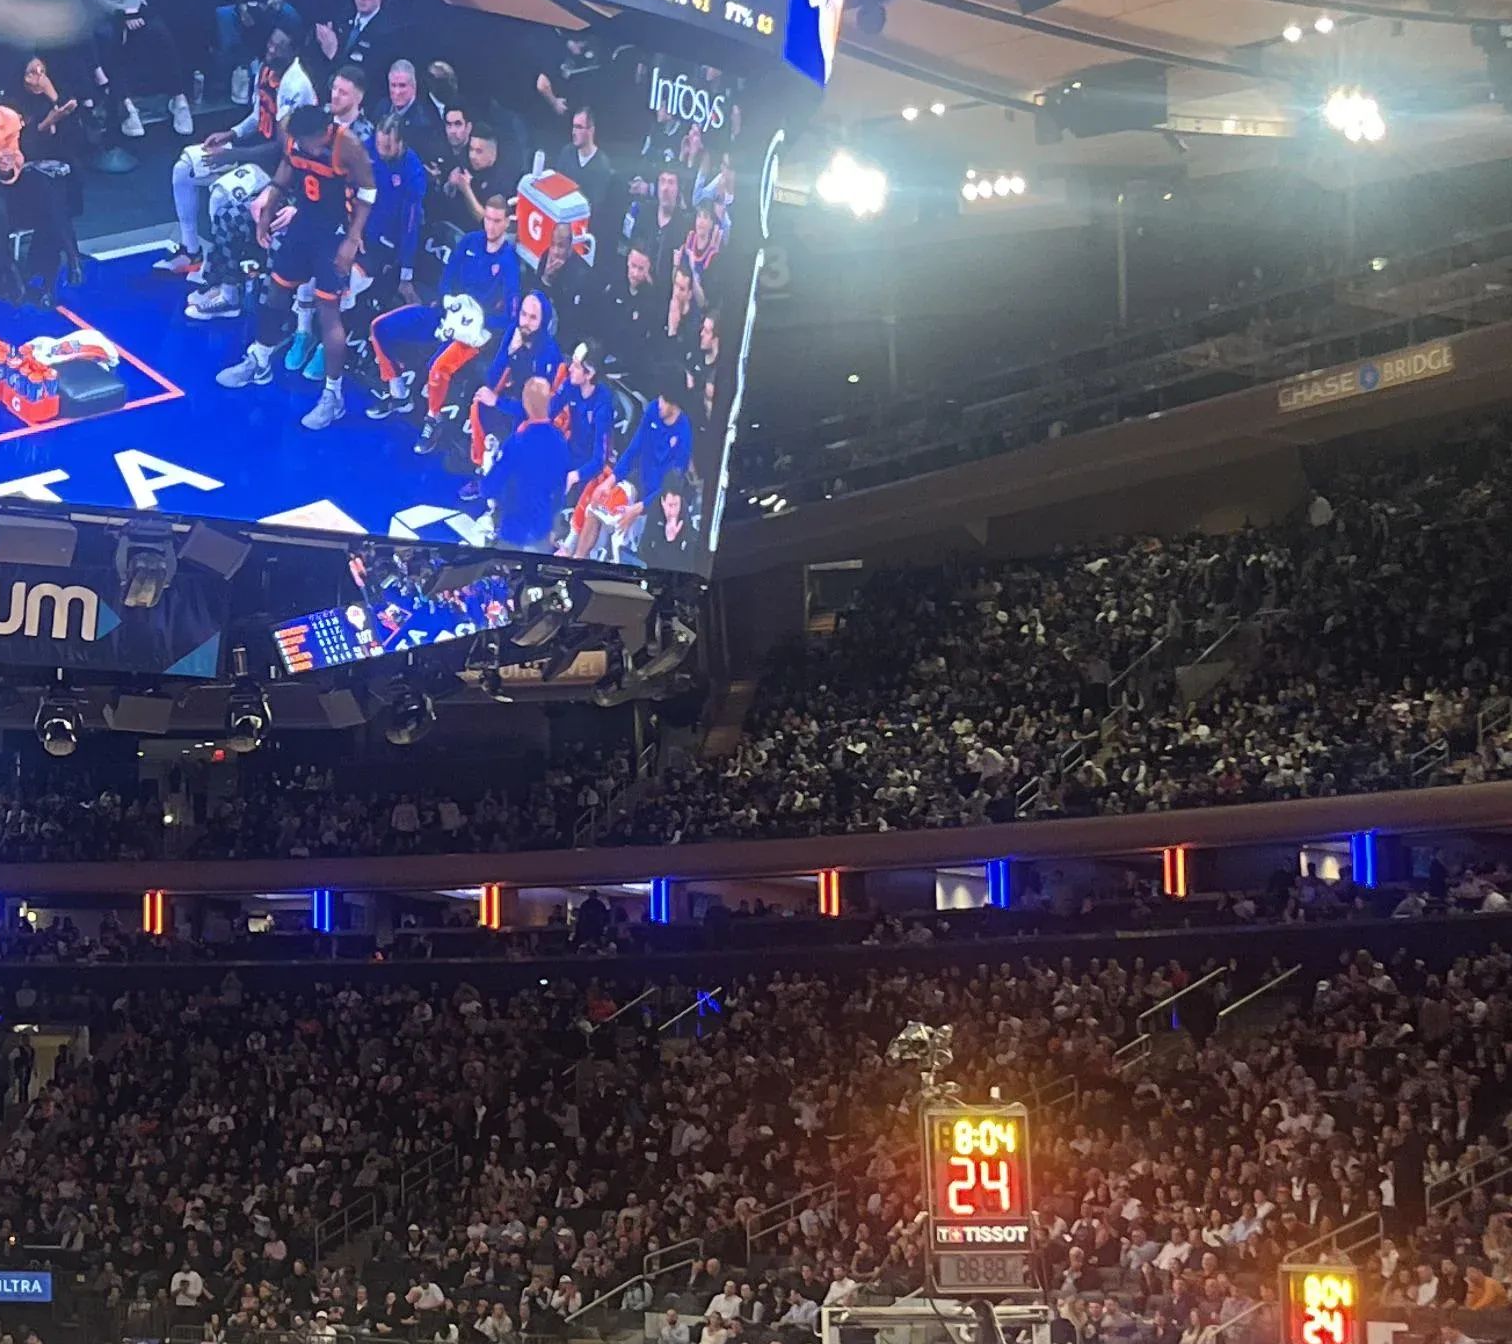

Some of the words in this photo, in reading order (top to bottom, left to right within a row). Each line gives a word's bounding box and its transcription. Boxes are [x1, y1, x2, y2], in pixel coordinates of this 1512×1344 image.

[650, 66, 726, 130] Infosys
[1278, 371, 1355, 407] CHASE
[1382, 346, 1453, 382] BRIDGE
[953, 1119, 1016, 1155] 8:04
[948, 1156, 1010, 1215] 24
[964, 1226, 1028, 1243] TISSOT
